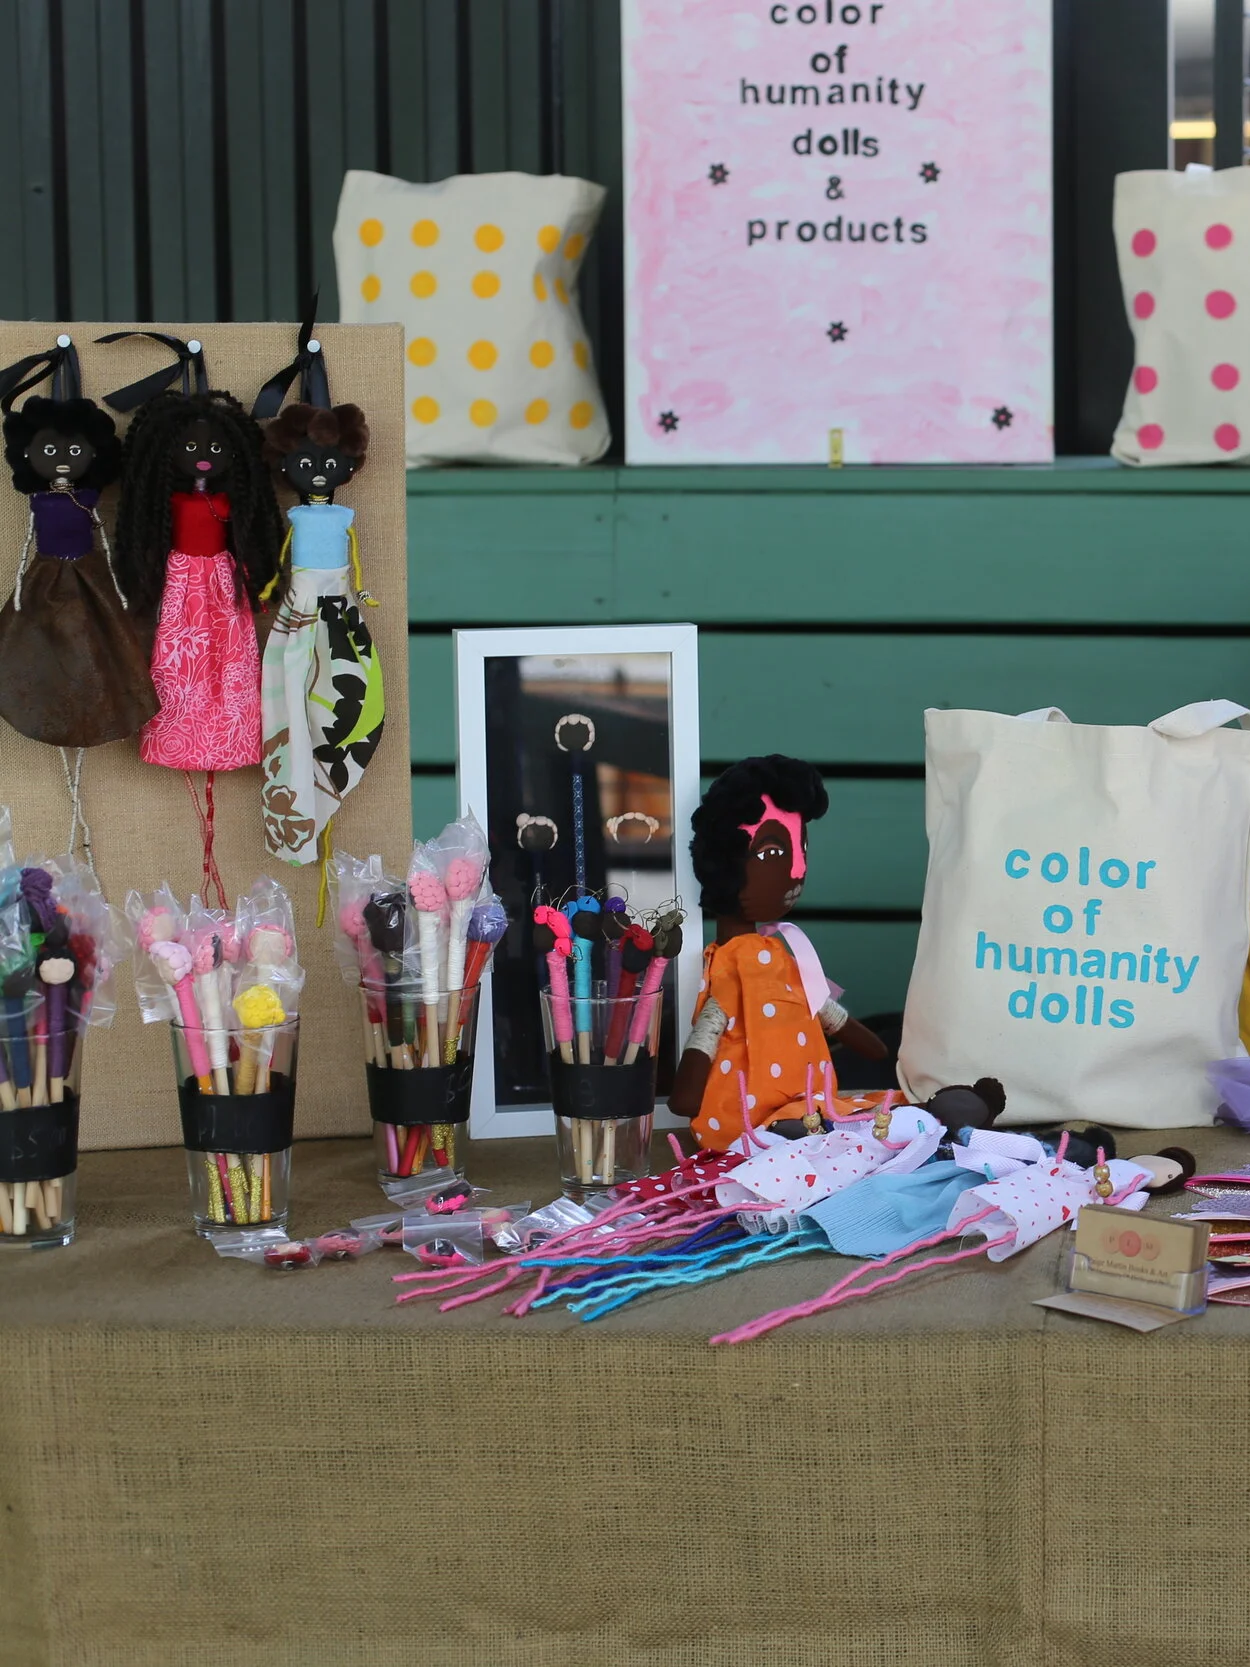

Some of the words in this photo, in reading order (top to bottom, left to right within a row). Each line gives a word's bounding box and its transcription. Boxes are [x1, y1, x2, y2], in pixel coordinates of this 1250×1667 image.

[770, 0, 884, 26] color
[810, 45, 848, 74] of
[740, 77, 925, 110] humanity
[792, 129, 880, 157] dolls
[825, 176, 845, 200] &
[747, 216, 929, 247] products
[1005, 846, 1156, 889] color
[1043, 898, 1102, 936] of
[975, 931, 1200, 994] humanity
[1008, 981, 1135, 1028] dolls
